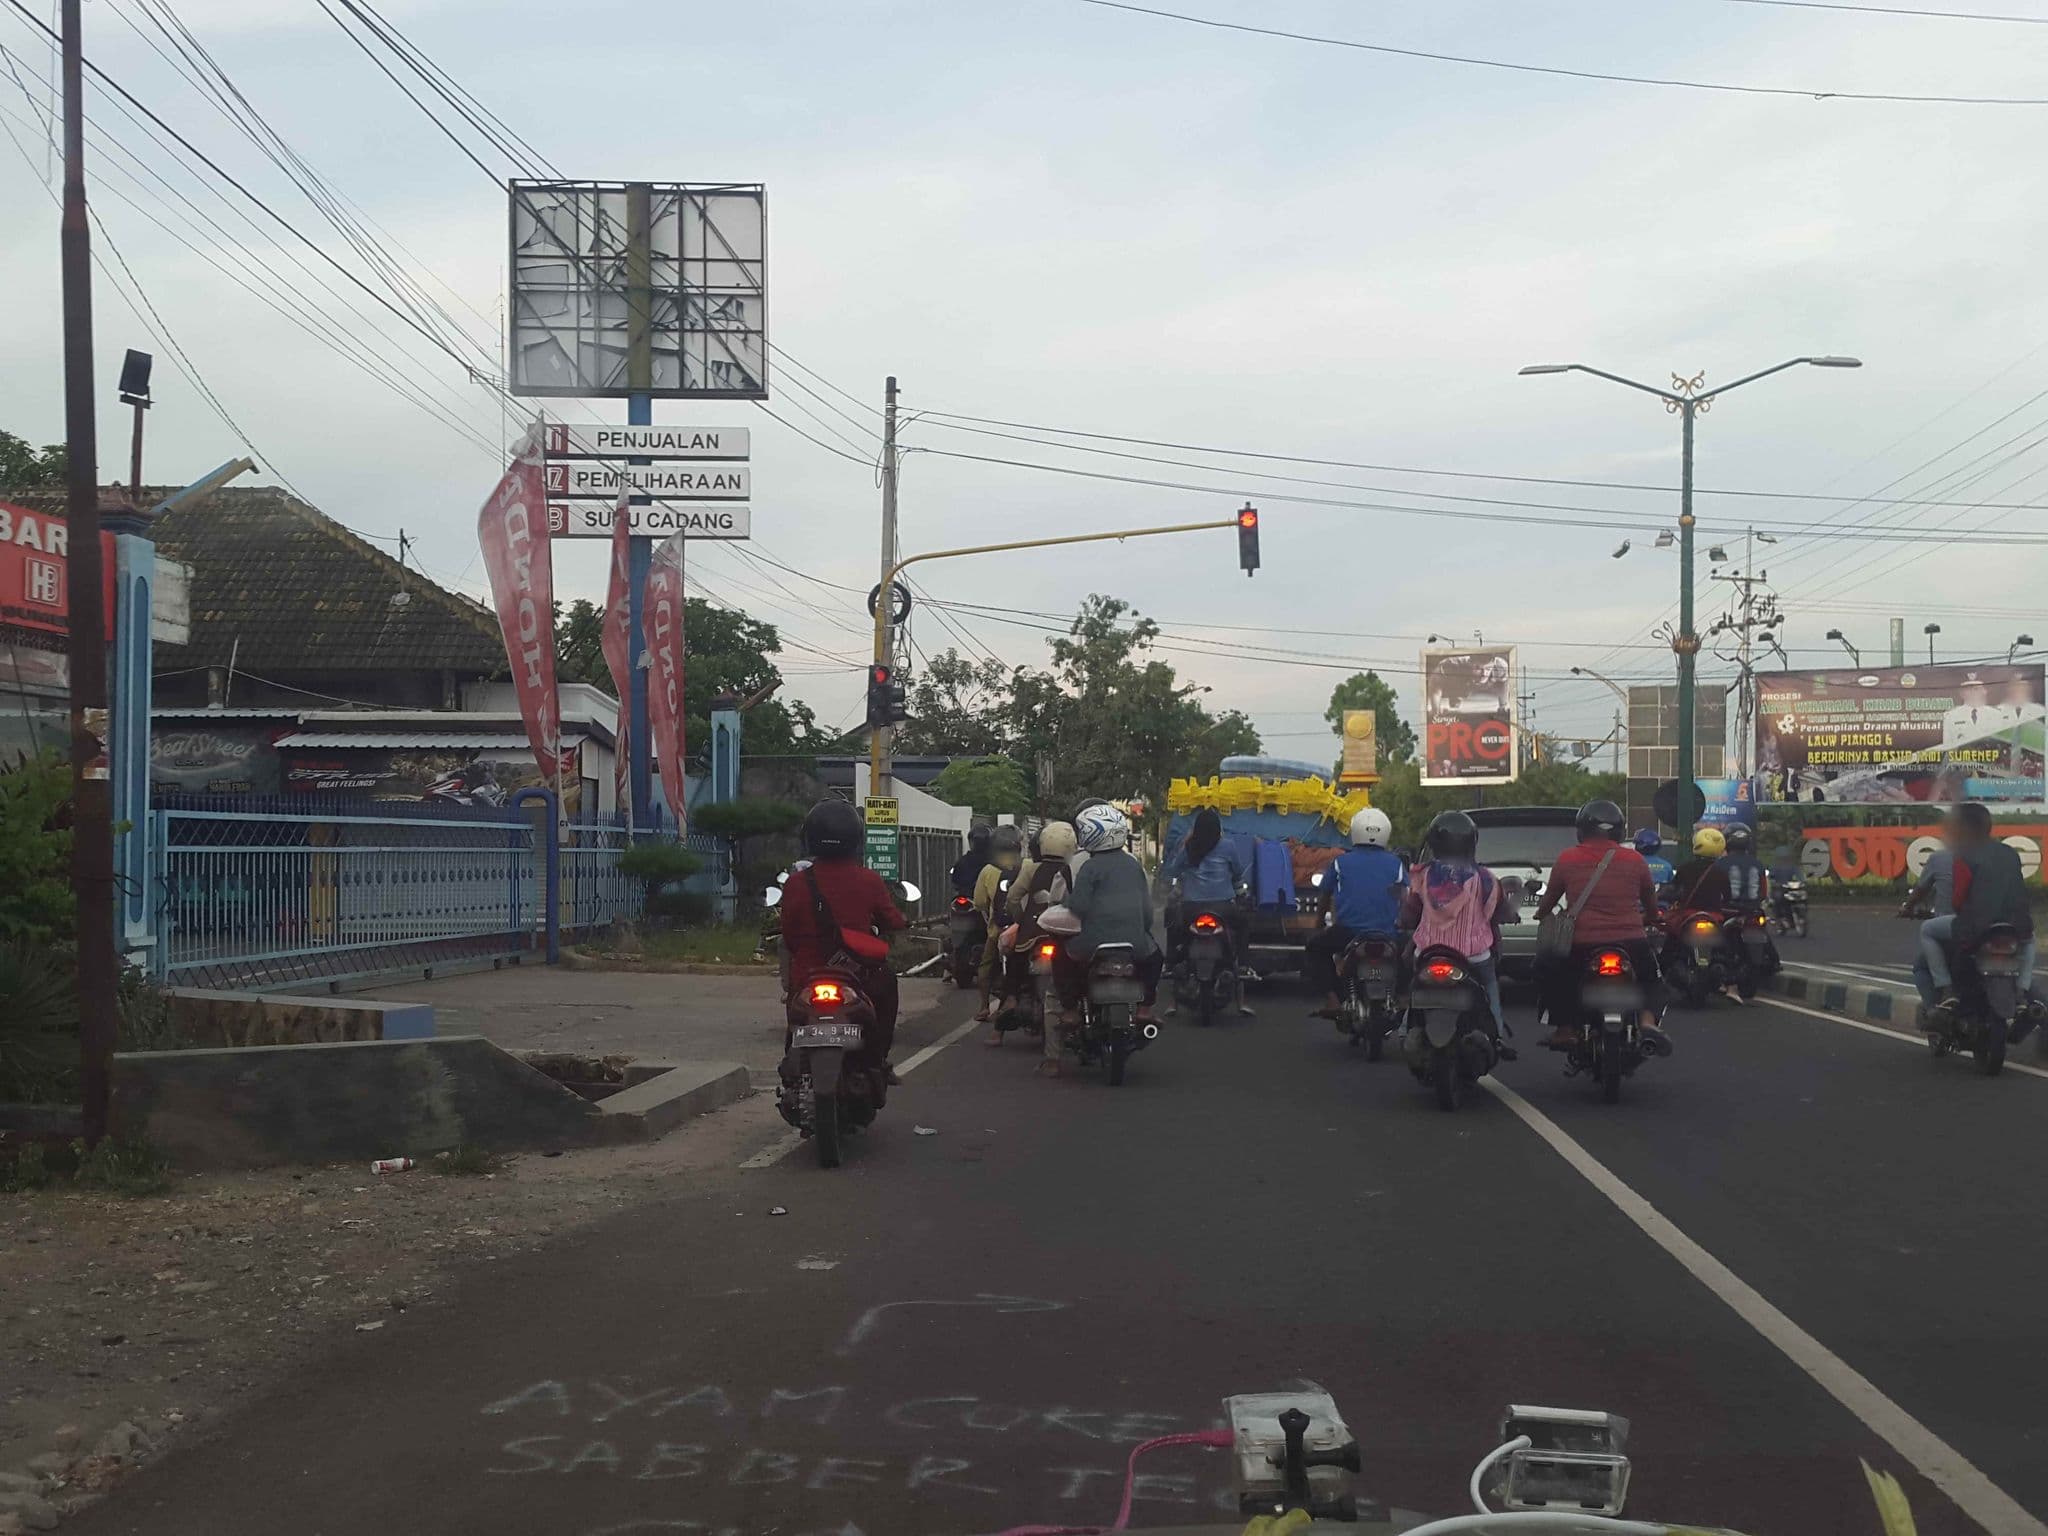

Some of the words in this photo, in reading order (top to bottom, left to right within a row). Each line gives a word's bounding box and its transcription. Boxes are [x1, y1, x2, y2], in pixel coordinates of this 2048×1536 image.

[597, 431, 719, 449] PENJUALAN
[585, 510, 640, 528] SUU
[646, 511, 734, 529] CADANG
[1800, 722, 1860, 733] Penampilan
[1863, 721, 1898, 732] Drama
[1900, 721, 1941, 731] Musikal
[1427, 720, 1510, 761] PRO
[1807, 734, 1837, 747] LAUW
[1807, 750, 1870, 764] BERDIRINYA
[1948, 749, 1999, 762] SUMENEP
[479, 1379, 853, 1425] AYAM
